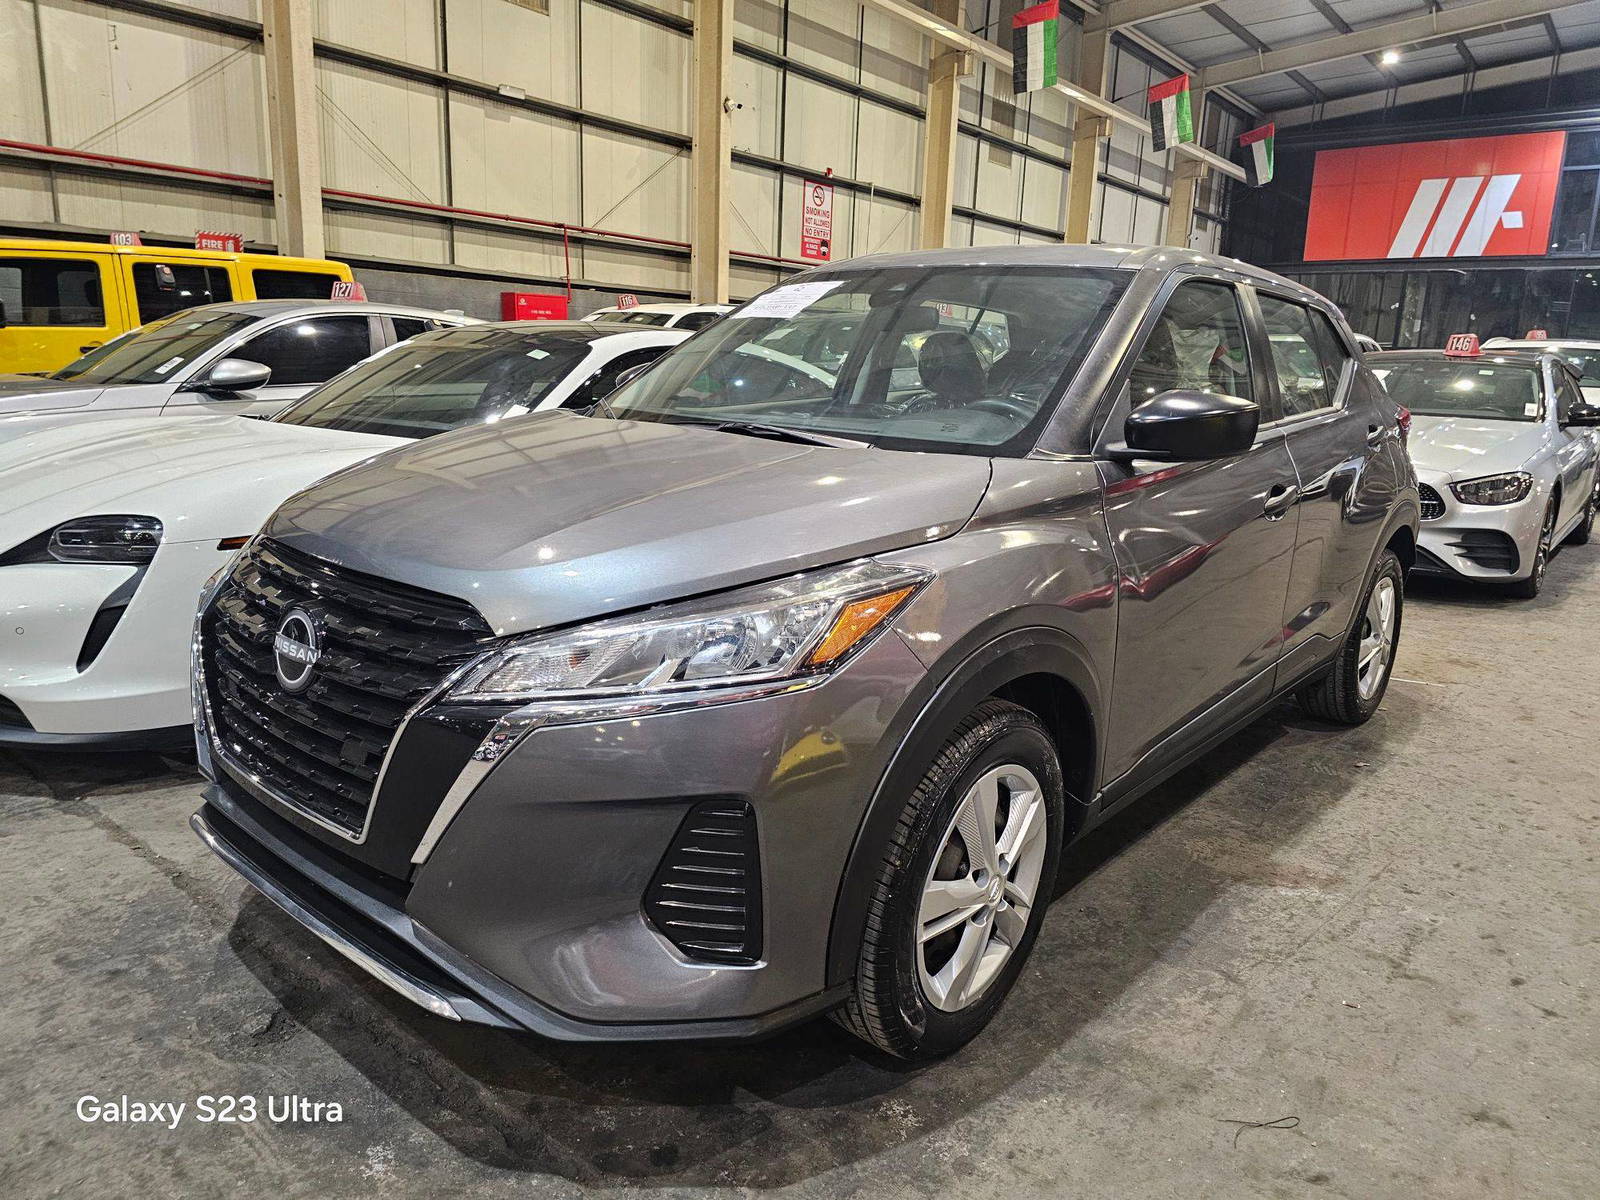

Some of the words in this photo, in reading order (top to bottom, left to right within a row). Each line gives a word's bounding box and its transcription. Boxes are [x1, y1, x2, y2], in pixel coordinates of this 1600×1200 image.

[805, 206, 830, 218] SMOKING
[813, 218, 830, 229] ALLOWED
[804, 227, 813, 235] NO
[813, 229, 829, 239] ENTRY
[114, 233, 132, 246] 103
[202, 239, 223, 250] FIRE
[335, 282, 352, 297] 127
[1451, 337, 1471, 351] 146
[274, 635, 318, 663] NISSAN
